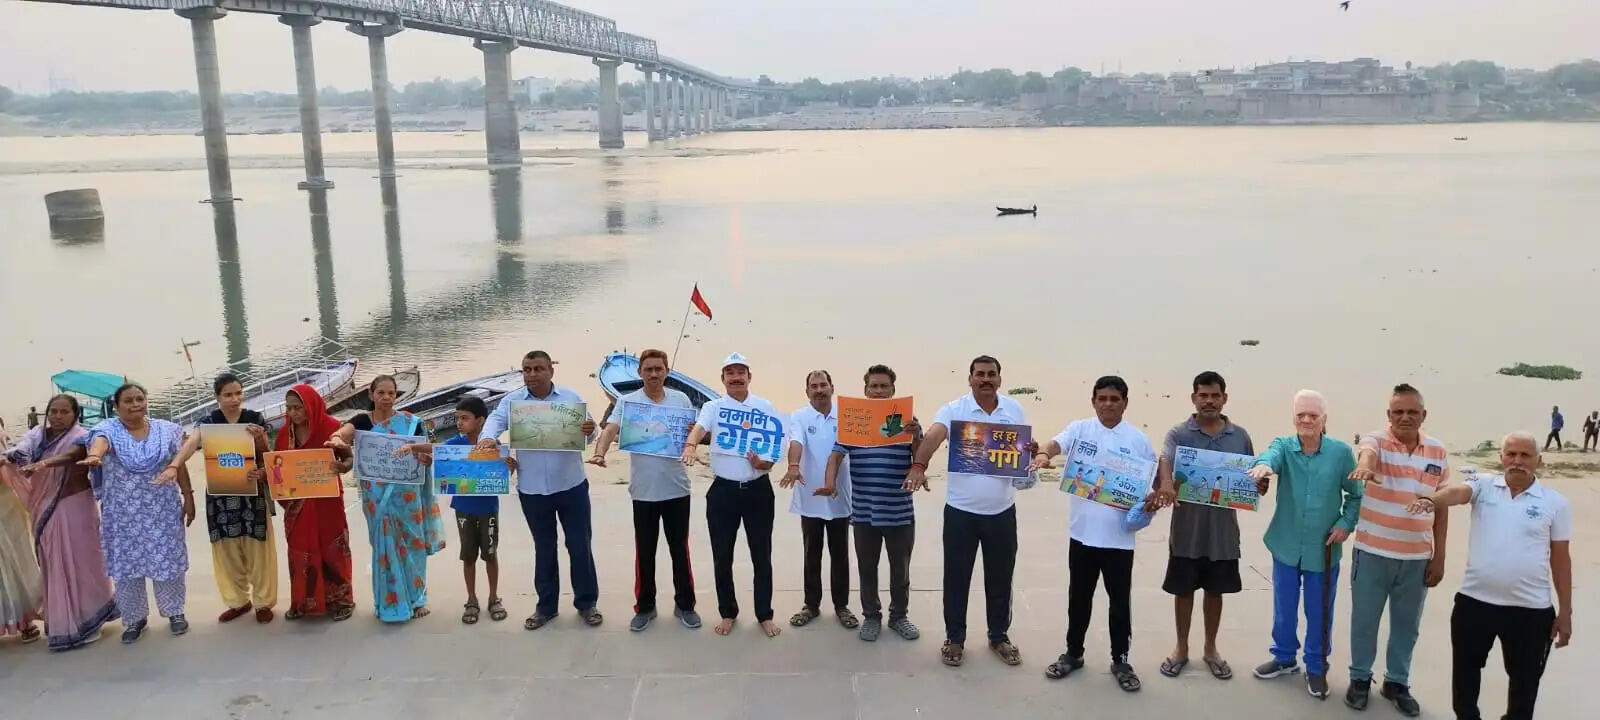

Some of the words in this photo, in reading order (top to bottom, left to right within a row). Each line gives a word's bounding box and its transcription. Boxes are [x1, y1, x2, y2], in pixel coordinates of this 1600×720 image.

[719, 407, 769, 429] नमामि
[716, 416, 785, 462] गंगे
[992, 430, 1004, 441] हर
[1006, 431, 1018, 442] हर
[987, 444, 1021, 470] गंगे
